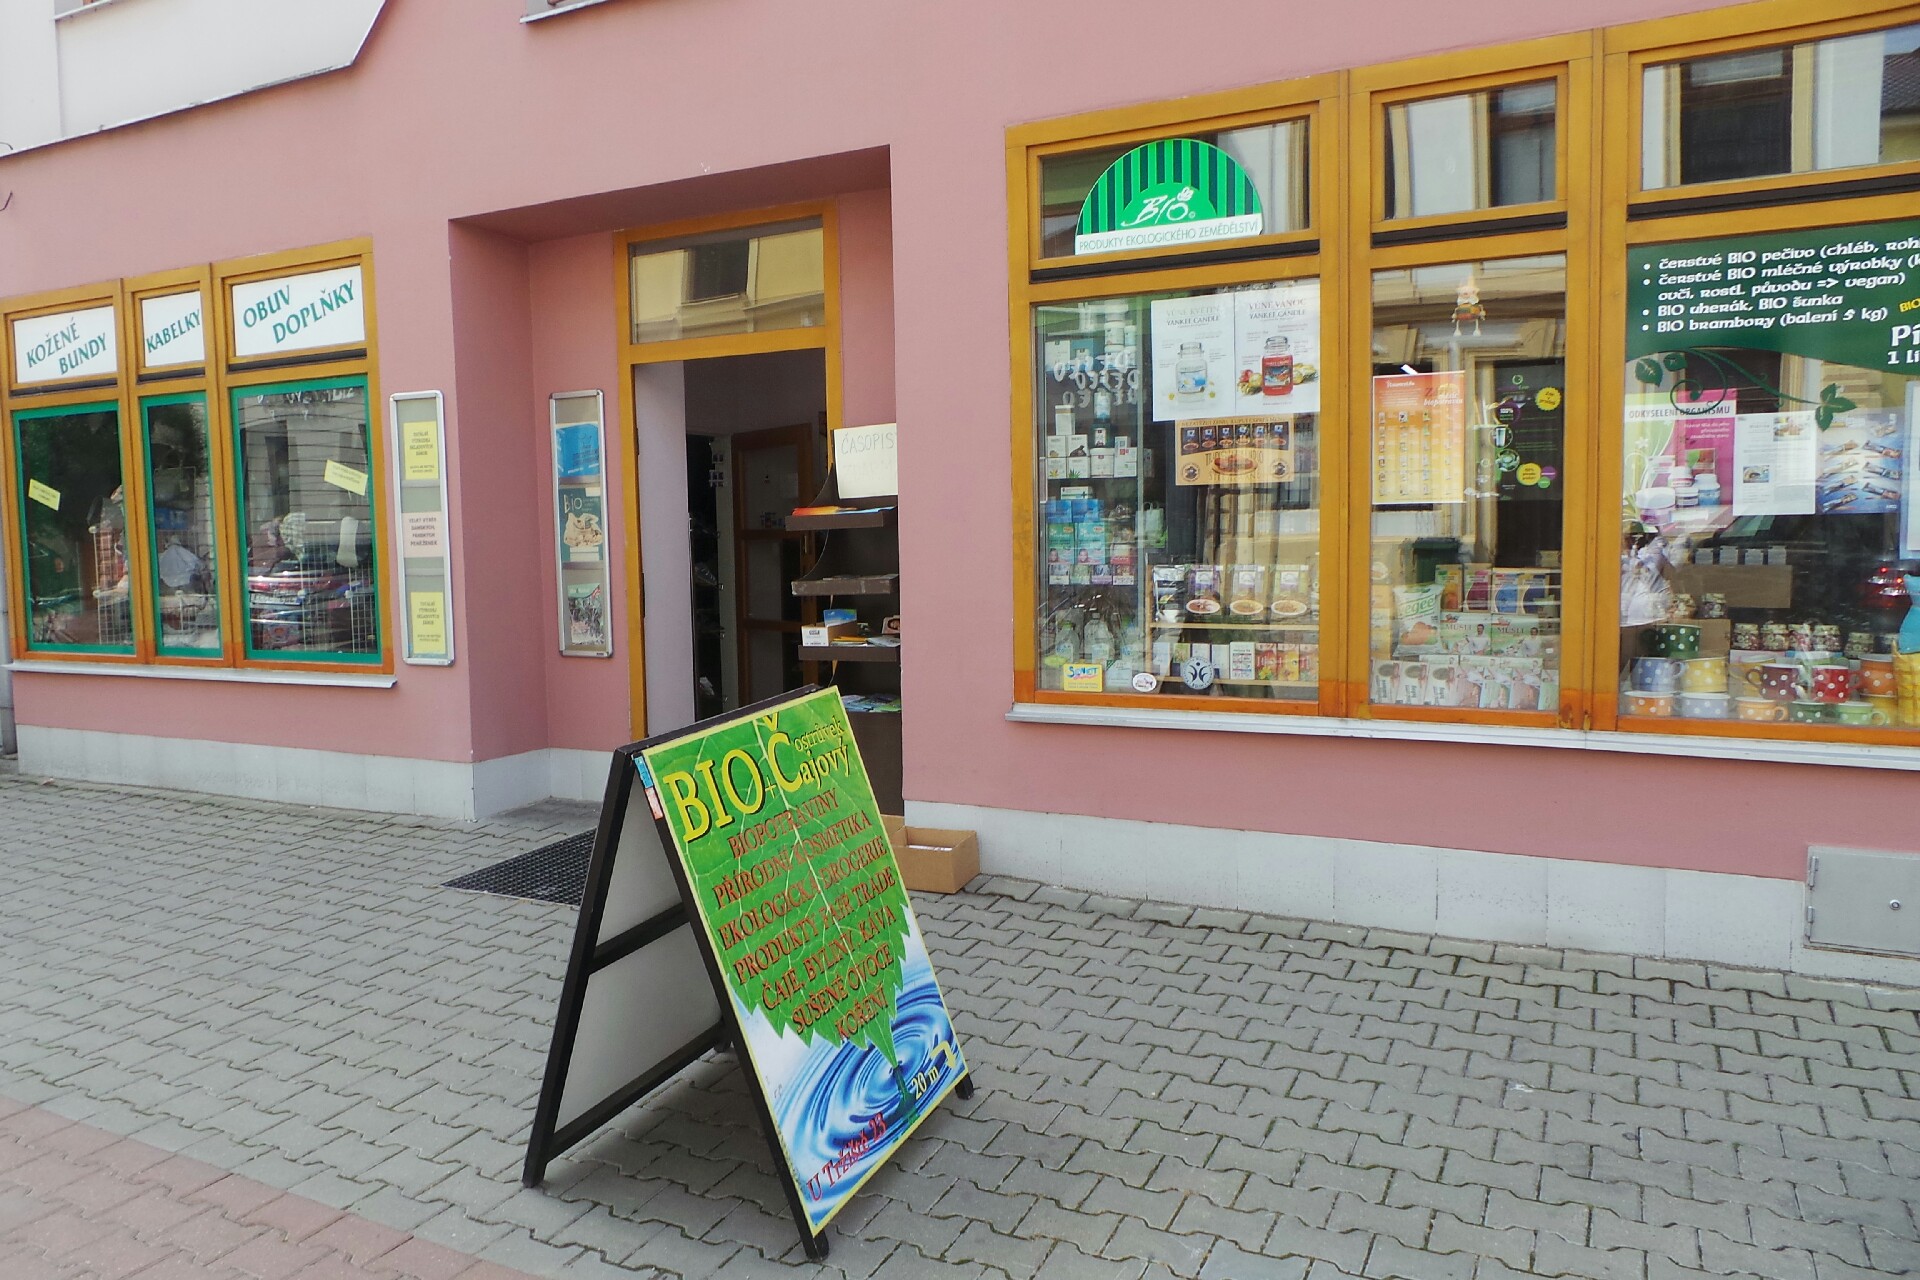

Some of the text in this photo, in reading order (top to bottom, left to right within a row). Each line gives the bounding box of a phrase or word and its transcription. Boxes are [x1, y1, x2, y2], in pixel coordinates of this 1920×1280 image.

[1121, 195, 1188, 227] BIO
[1080, 219, 1258, 251] PRODUKTY EKOLOGICKÉHO ZEMĚDĚLSTVÍ
[1659, 236, 1920, 269] čerstvé BIO pečivo (chléb, roh
[1658, 270, 1722, 285] čerstvé
[1727, 267, 1756, 280] BIO
[1761, 261, 1823, 277] mléčné
[1828, 256, 1902, 274] výrobky
[1751, 281, 1812, 297] původu
[1844, 272, 1906, 289] vegan)
[243, 285, 291, 329] OBUV
[272, 279, 356, 344] DOPLŇKY
[1657, 293, 1843, 317] BIO uherák, BIO šunka
[1657, 307, 1888, 333] BIO brambory (balení 5 kg)
[25, 317, 80, 368] KOŽENÉ
[146, 309, 200, 353] KABELKY
[59, 333, 107, 375] BUNDY
[1887, 351, 1900, 364] 1
[841, 432, 897, 454] ČASOPIS
[794, 716, 845, 752] ostrůvek
[663, 749, 766, 843] BIO
[762, 712, 850, 793] Čajový
[727, 788, 839, 860] BIOPOTRAVINY
[713, 809, 872, 910] PŘÍRODNÍ KOSMETIKA
[718, 836, 887, 950] EKOLOGICKÁ DROGERIE
[733, 870, 896, 985] PRODUKTY FAIR TRADE
[858, 905, 896, 943] KÁVA
[792, 943, 894, 1034] SUŠENÉ OVOCE
[835, 982, 889, 1040] KOŘENÍ
[911, 1066, 939, 1100] 20 m
[806, 1173, 822, 1201] U
[868, 1111, 887, 1143] 23
